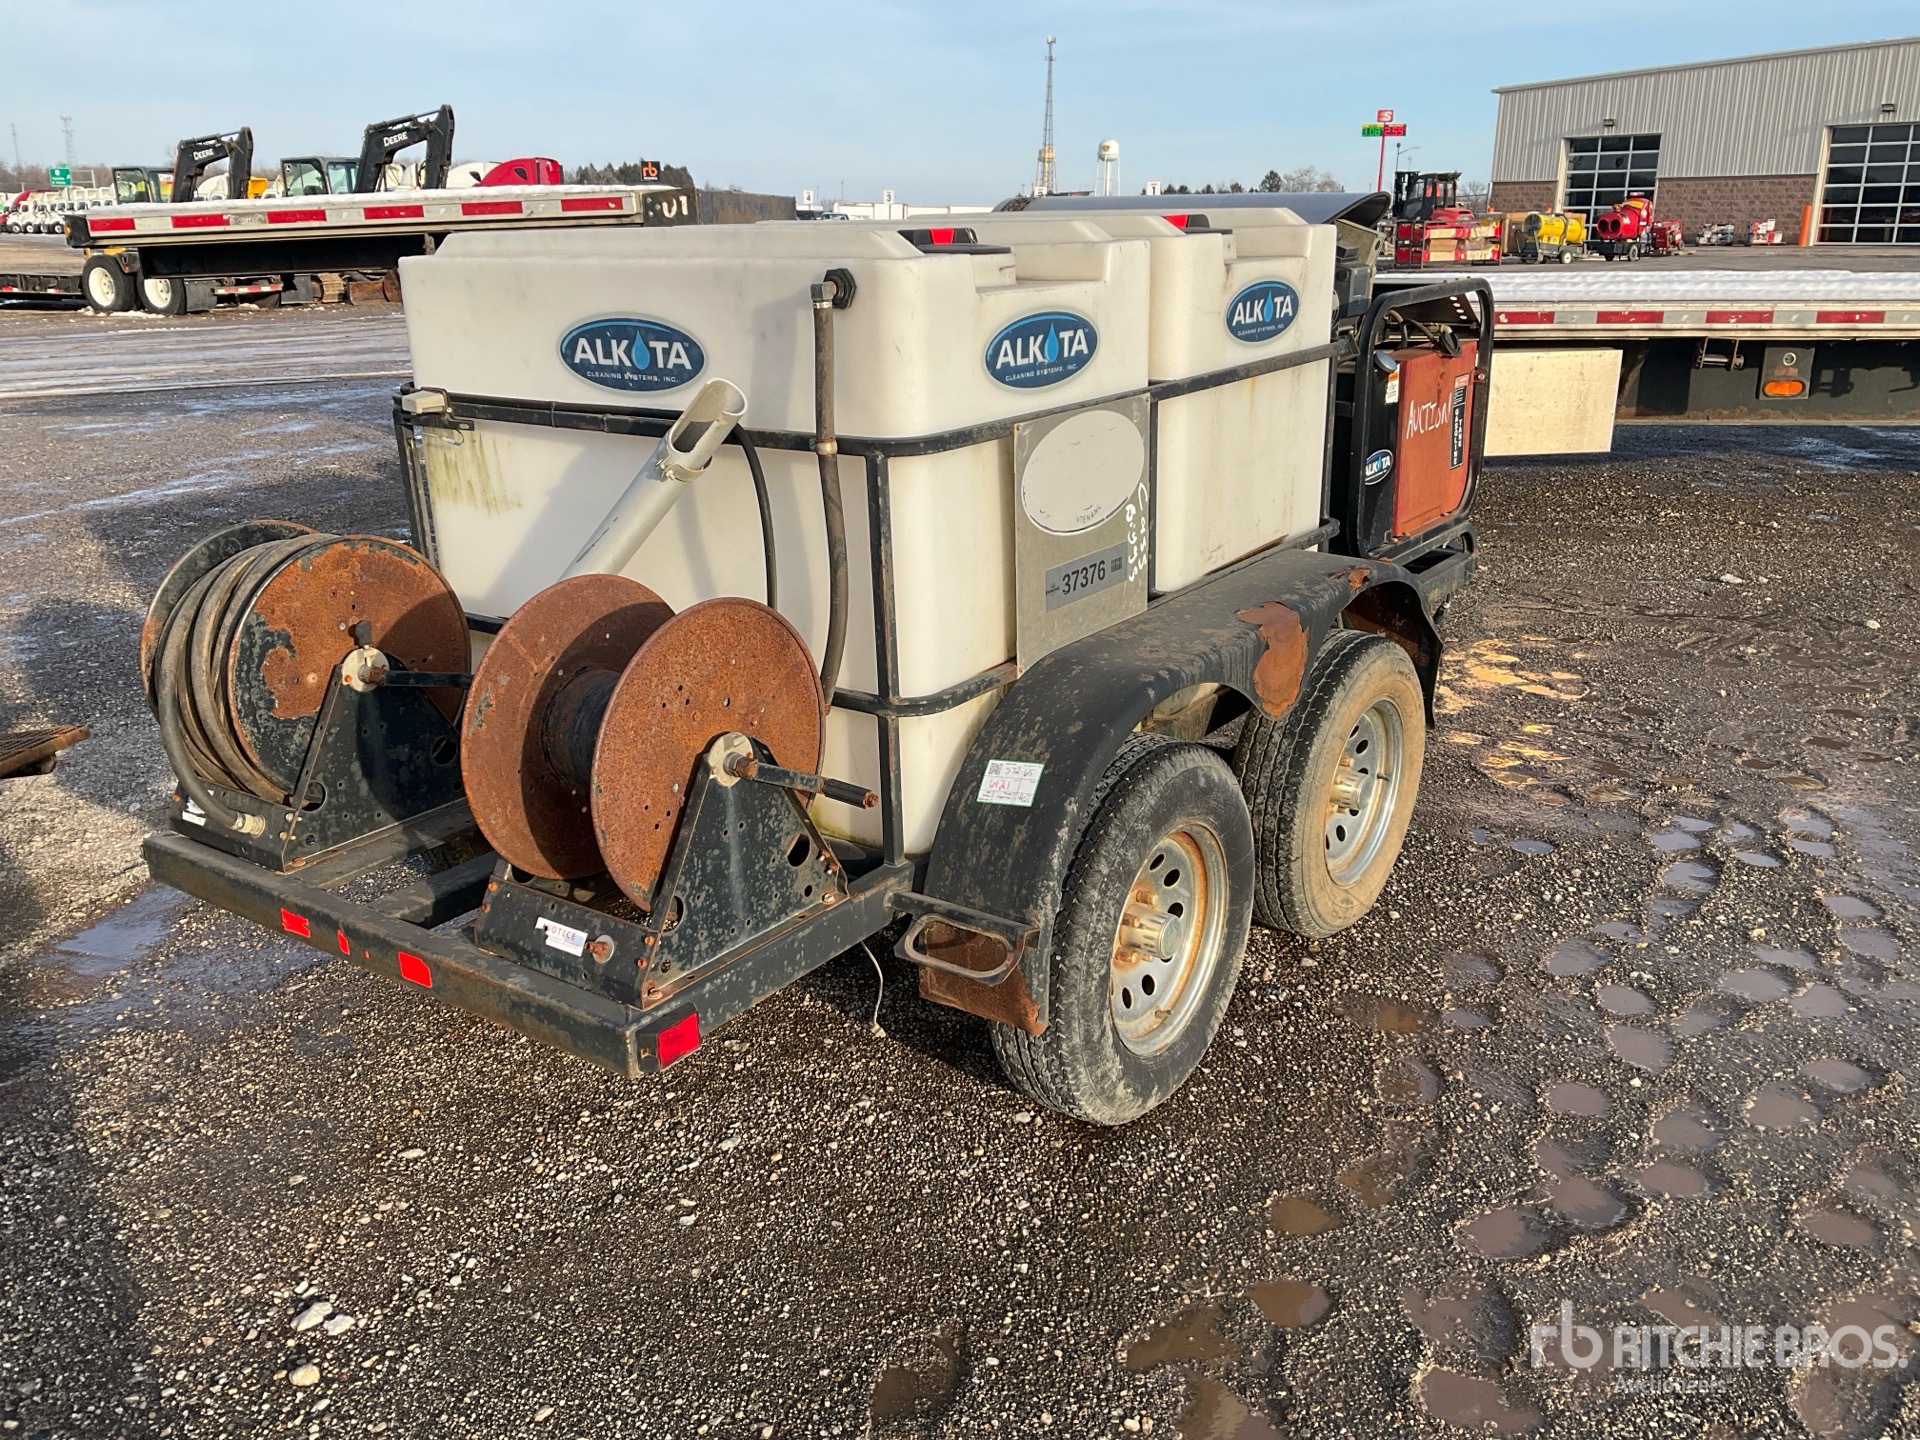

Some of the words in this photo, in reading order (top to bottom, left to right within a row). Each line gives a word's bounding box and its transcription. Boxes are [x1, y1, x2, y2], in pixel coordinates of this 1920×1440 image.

[383, 131, 408, 147] DEERE
[193, 148, 214, 160] DEERE
[642, 160, 658, 177] rb
[587, 371, 622, 379] CLEANING
[624, 372, 661, 382] SYSTEMS,
[1005, 371, 1035, 381] CLEANING
[1062, 560, 1106, 595] 37376
